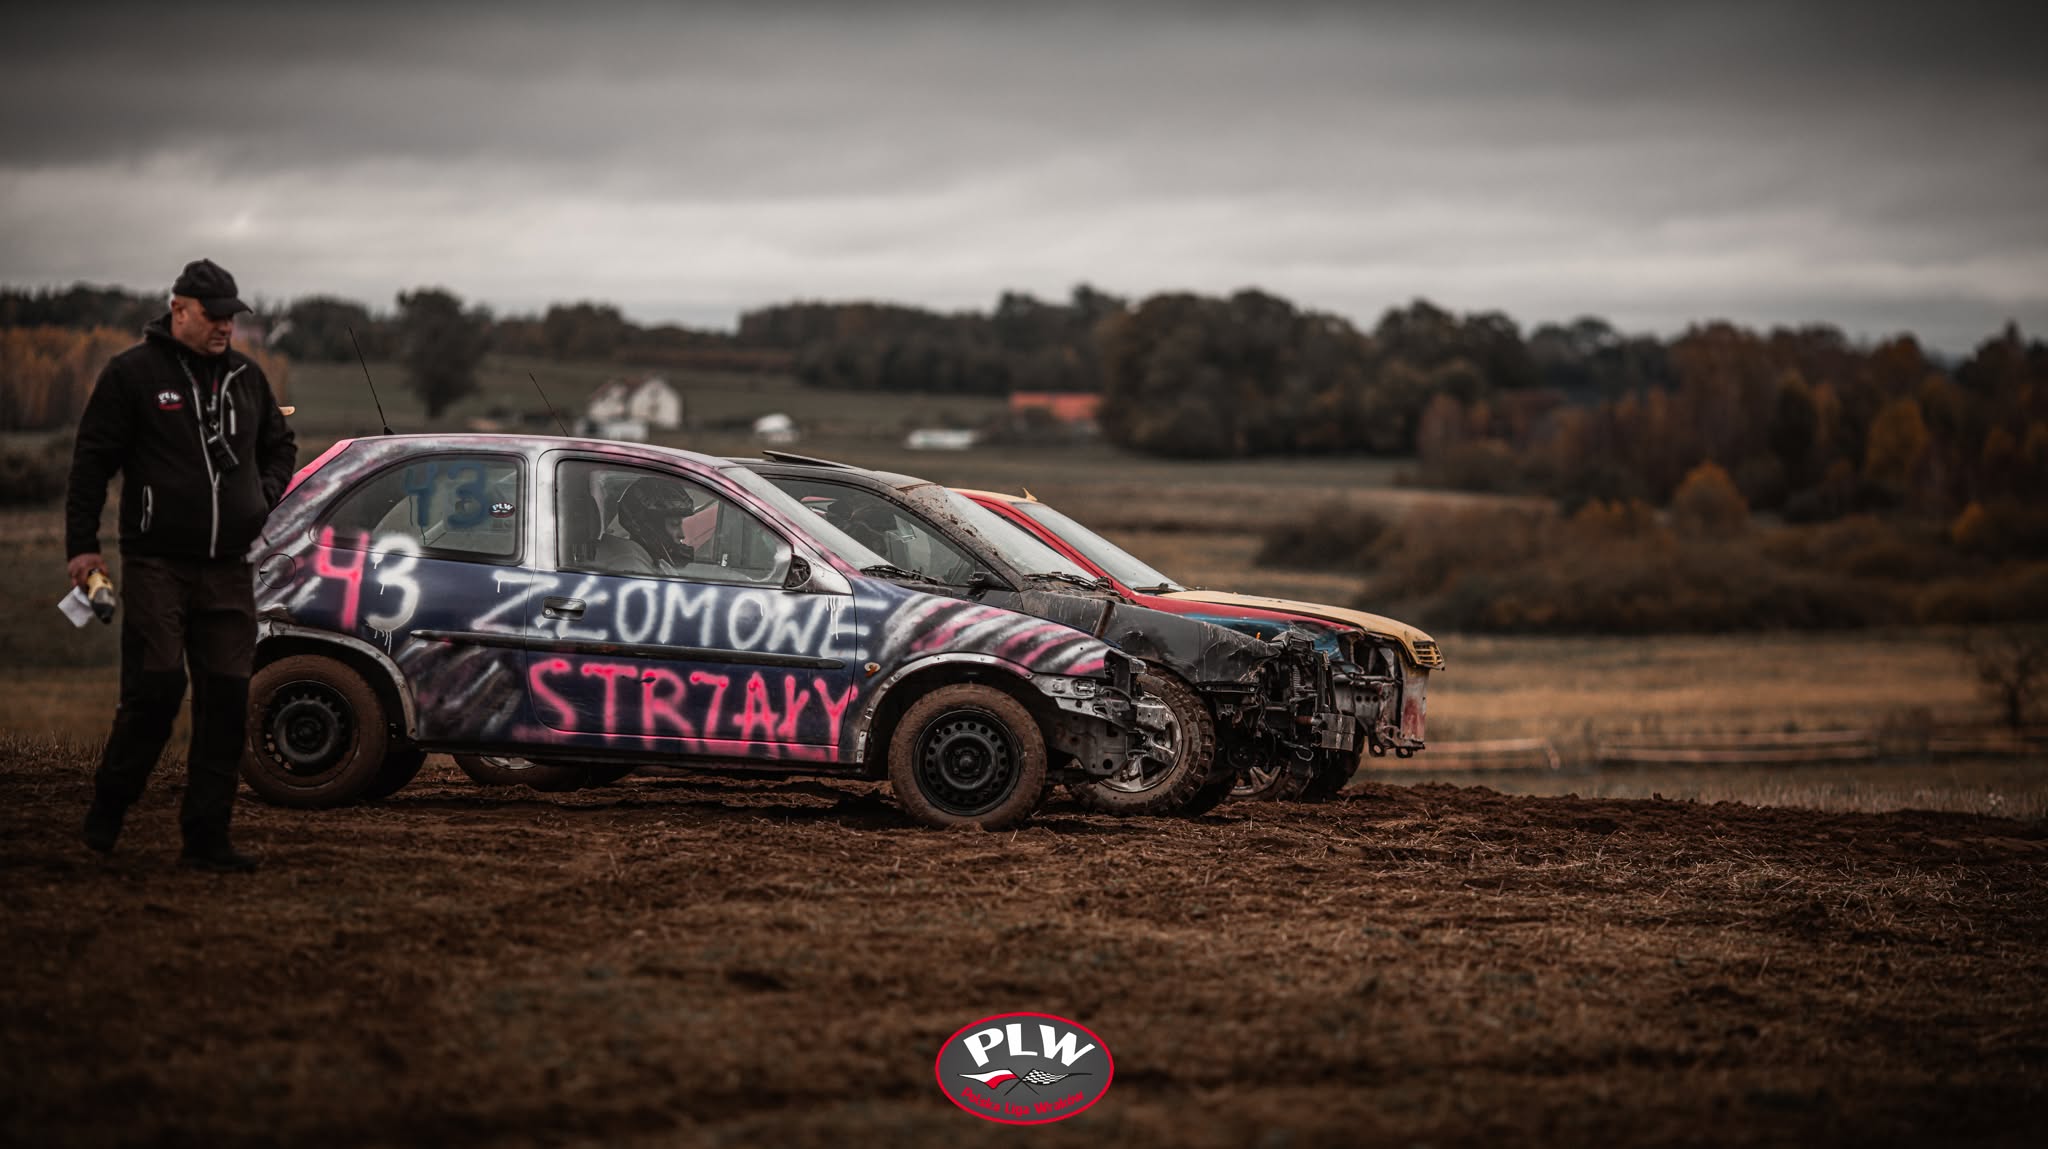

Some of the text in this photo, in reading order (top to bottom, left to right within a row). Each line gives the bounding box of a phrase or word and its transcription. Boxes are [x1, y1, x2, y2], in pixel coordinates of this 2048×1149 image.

[404, 461, 488, 529] 43
[492, 503, 513, 511] PLW
[315, 525, 420, 635] 43
[471, 569, 888, 663] ZŁOMOWE
